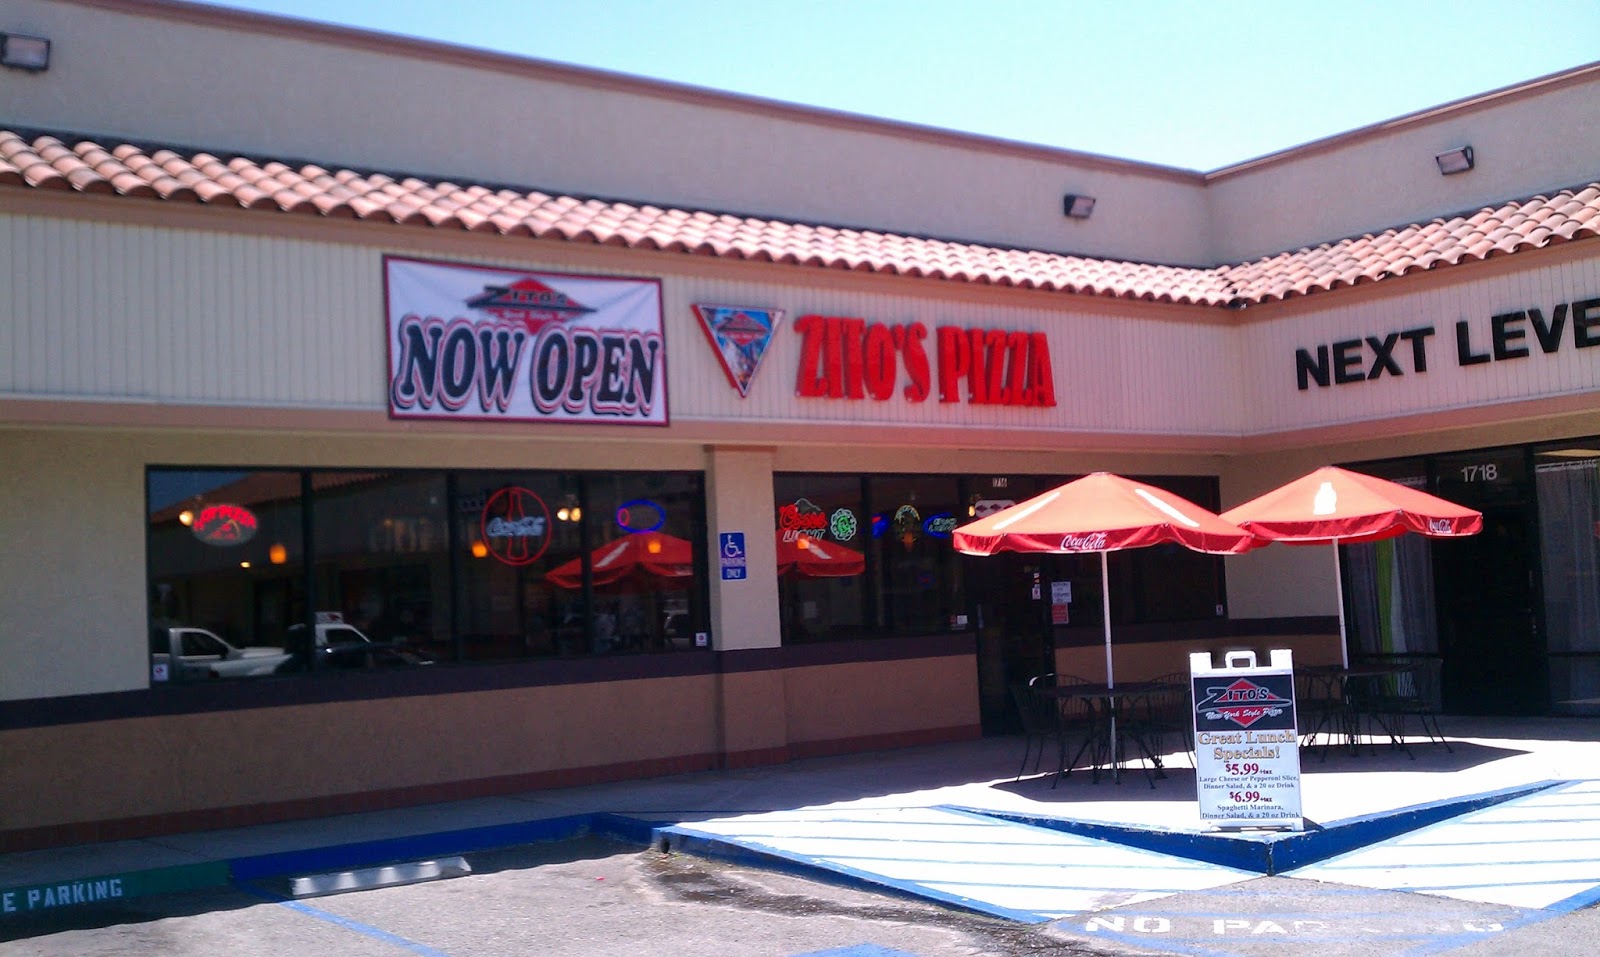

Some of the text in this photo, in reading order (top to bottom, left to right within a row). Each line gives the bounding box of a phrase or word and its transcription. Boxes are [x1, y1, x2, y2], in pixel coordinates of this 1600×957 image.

[1295, 298, 1600, 390] NEXT LEVE
[394, 313, 664, 417] NOW OPEN
[793, 314, 1057, 407] ZITO'S PIZZA
[1461, 463, 1498, 482] 1718
[779, 504, 828, 533] Coors
[1060, 532, 1107, 550] Coca-Cola
[1196, 686, 1293, 713] ZITO'S
[1206, 706, 1283, 720] New York Style Pizza
[1197, 730, 1296, 745] Great Lunch
[1214, 746, 1281, 762] Specials!
[1225, 763, 1259, 775] $5.99
[1229, 791, 1260, 803] $6.99
[3, 879, 122, 912] E PARKING
[1085, 917, 1170, 933] NO
